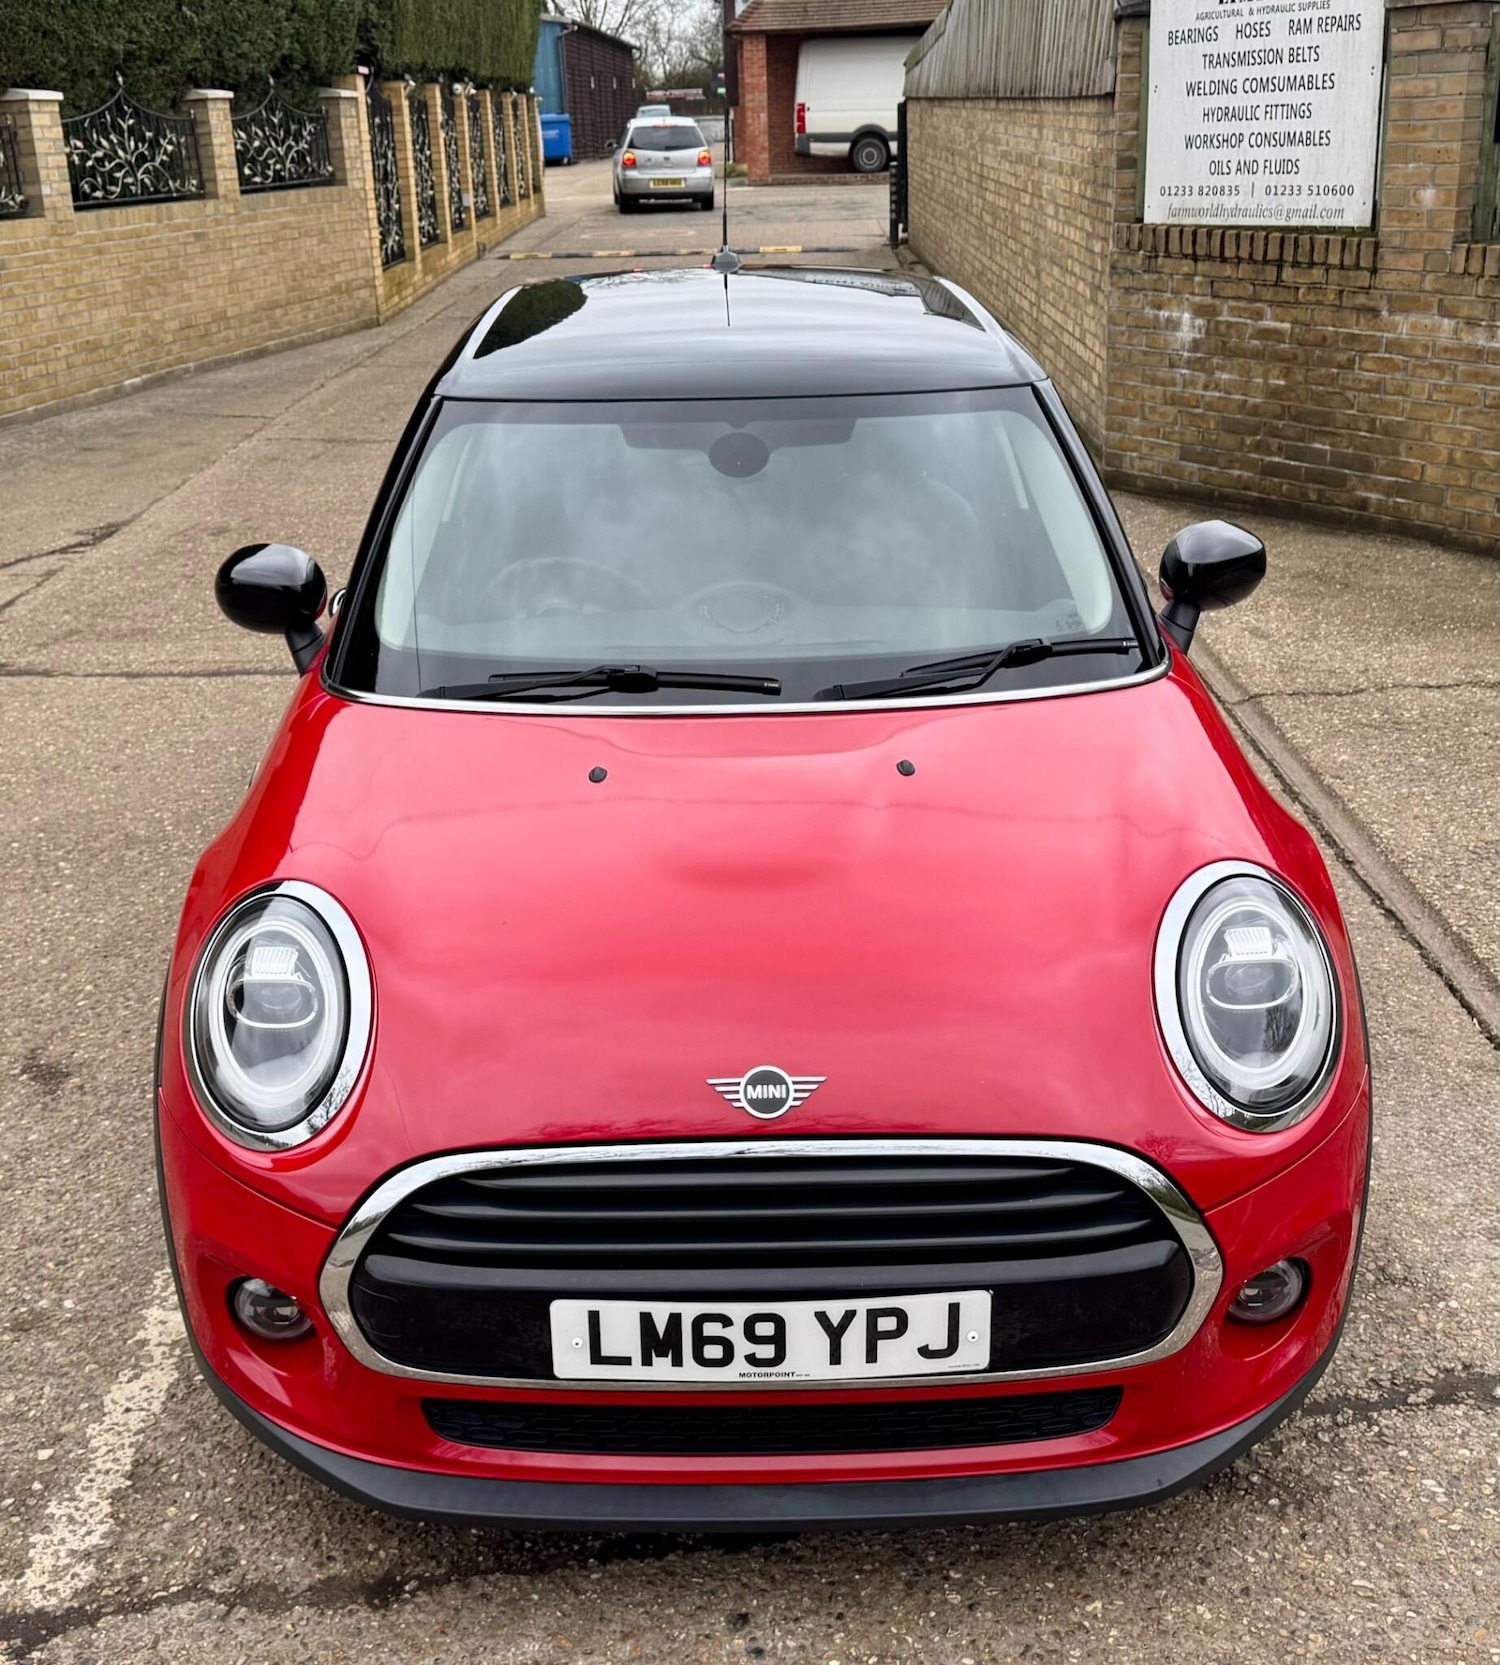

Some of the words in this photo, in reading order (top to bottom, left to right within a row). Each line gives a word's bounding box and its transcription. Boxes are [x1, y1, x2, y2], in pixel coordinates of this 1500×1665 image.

[1195, 9, 1244, 22] AGRICULTURAL
[1256, 3, 1296, 16] HYDRAULIC
[1297, 0, 1330, 12] SUPPLIES
[1167, 26, 1219, 46] BEARINGS
[1235, 21, 1271, 40] HOSES
[1288, 18, 1313, 36] RAM
[1317, 13, 1362, 34] REPAIRS
[1202, 48, 1283, 70] TRANSMISSION
[1288, 45, 1320, 63] BELTS
[1185, 78, 1238, 97] WELDING
[1242, 73, 1335, 94] COMSUMABLES
[1202, 104, 1260, 123] HYDRAULIC
[1264, 102, 1312, 120] FITTINGS
[1184, 132, 1244, 150] WORKSHOP
[1248, 130, 1331, 148] CONSUMABLES
[1209, 160, 1231, 176] OILS
[1235, 159, 1259, 175] AND
[1263, 158, 1300, 175] FLUIDS
[1159, 185, 1194, 197] 01233
[1197, 185, 1240, 197] 820835
[1264, 184, 1301, 196] 01233
[1307, 184, 1355, 196] 510600
[1167, 203, 1345, 222] farmworldhydraulics@gmail.com
[746, 1084, 787, 1099] MINI
[587, 1309, 787, 1368] LM69
[813, 1302, 961, 1366] YPJ
